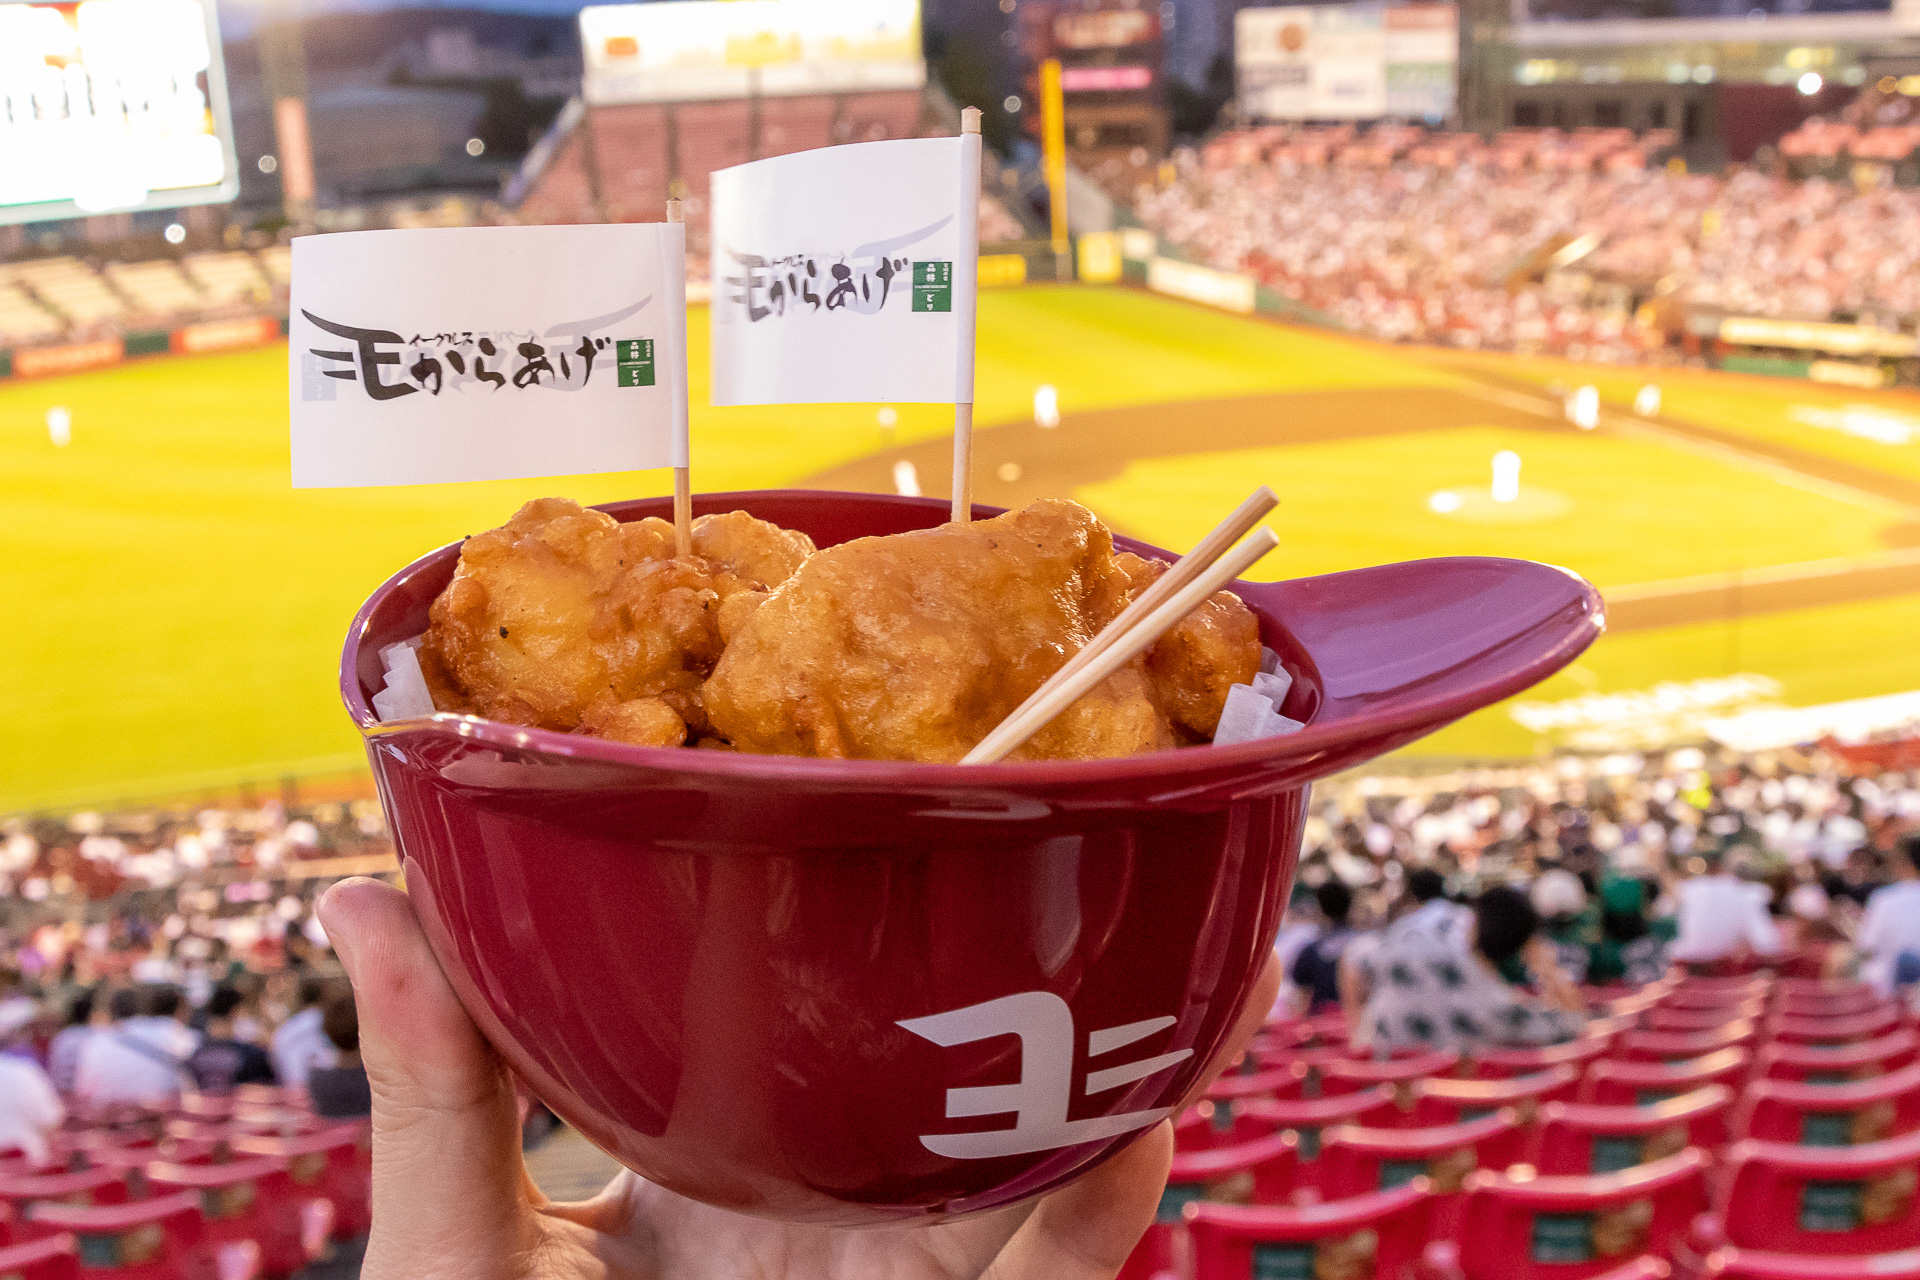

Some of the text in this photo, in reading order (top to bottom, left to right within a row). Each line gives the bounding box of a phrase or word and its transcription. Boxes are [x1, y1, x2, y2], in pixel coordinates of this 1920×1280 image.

[770, 256, 908, 317] からあげ
[410, 336, 611, 397] からあげ
